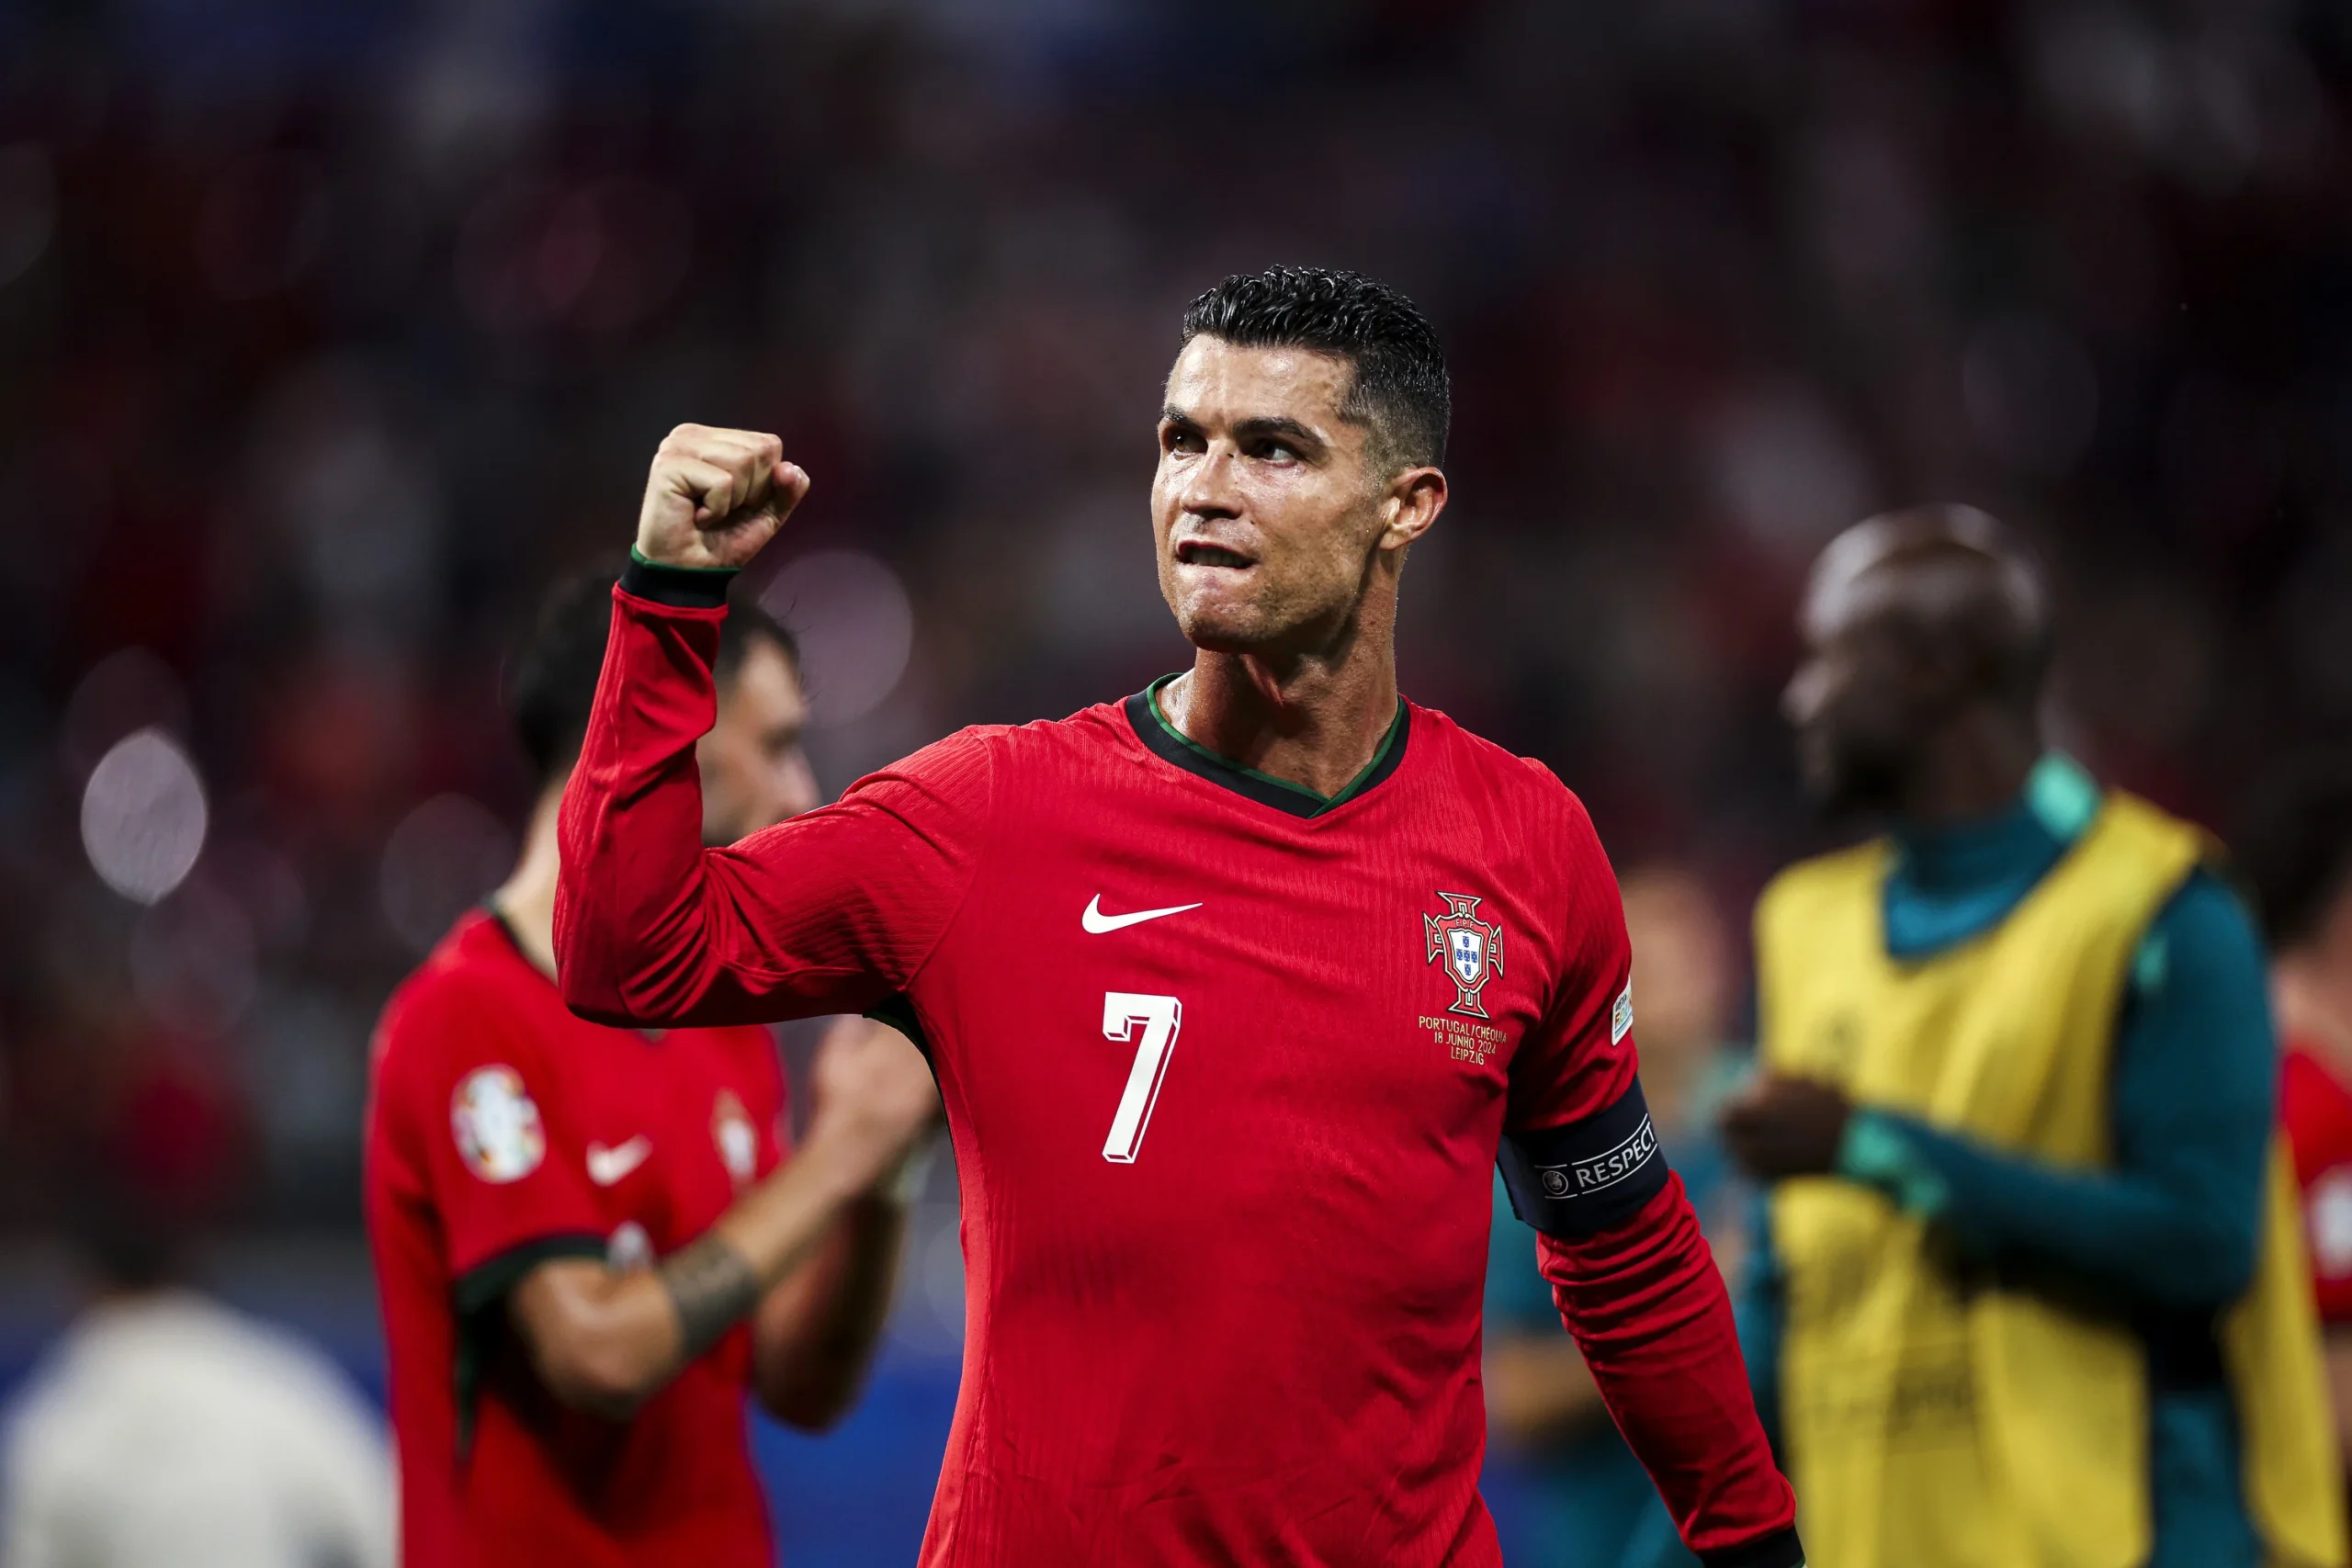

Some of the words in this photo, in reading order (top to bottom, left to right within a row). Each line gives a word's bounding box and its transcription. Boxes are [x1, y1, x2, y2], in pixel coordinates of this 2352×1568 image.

[1434, 1031, 1443, 1043] 18
[1445, 1032, 1475, 1050] JUNHO
[1477, 1039, 1497, 1055] 2024
[1451, 1046, 1485, 1066] LEIPZIG
[1102, 991, 1182, 1164] 7
[1576, 1121, 1655, 1188] RESPECT
